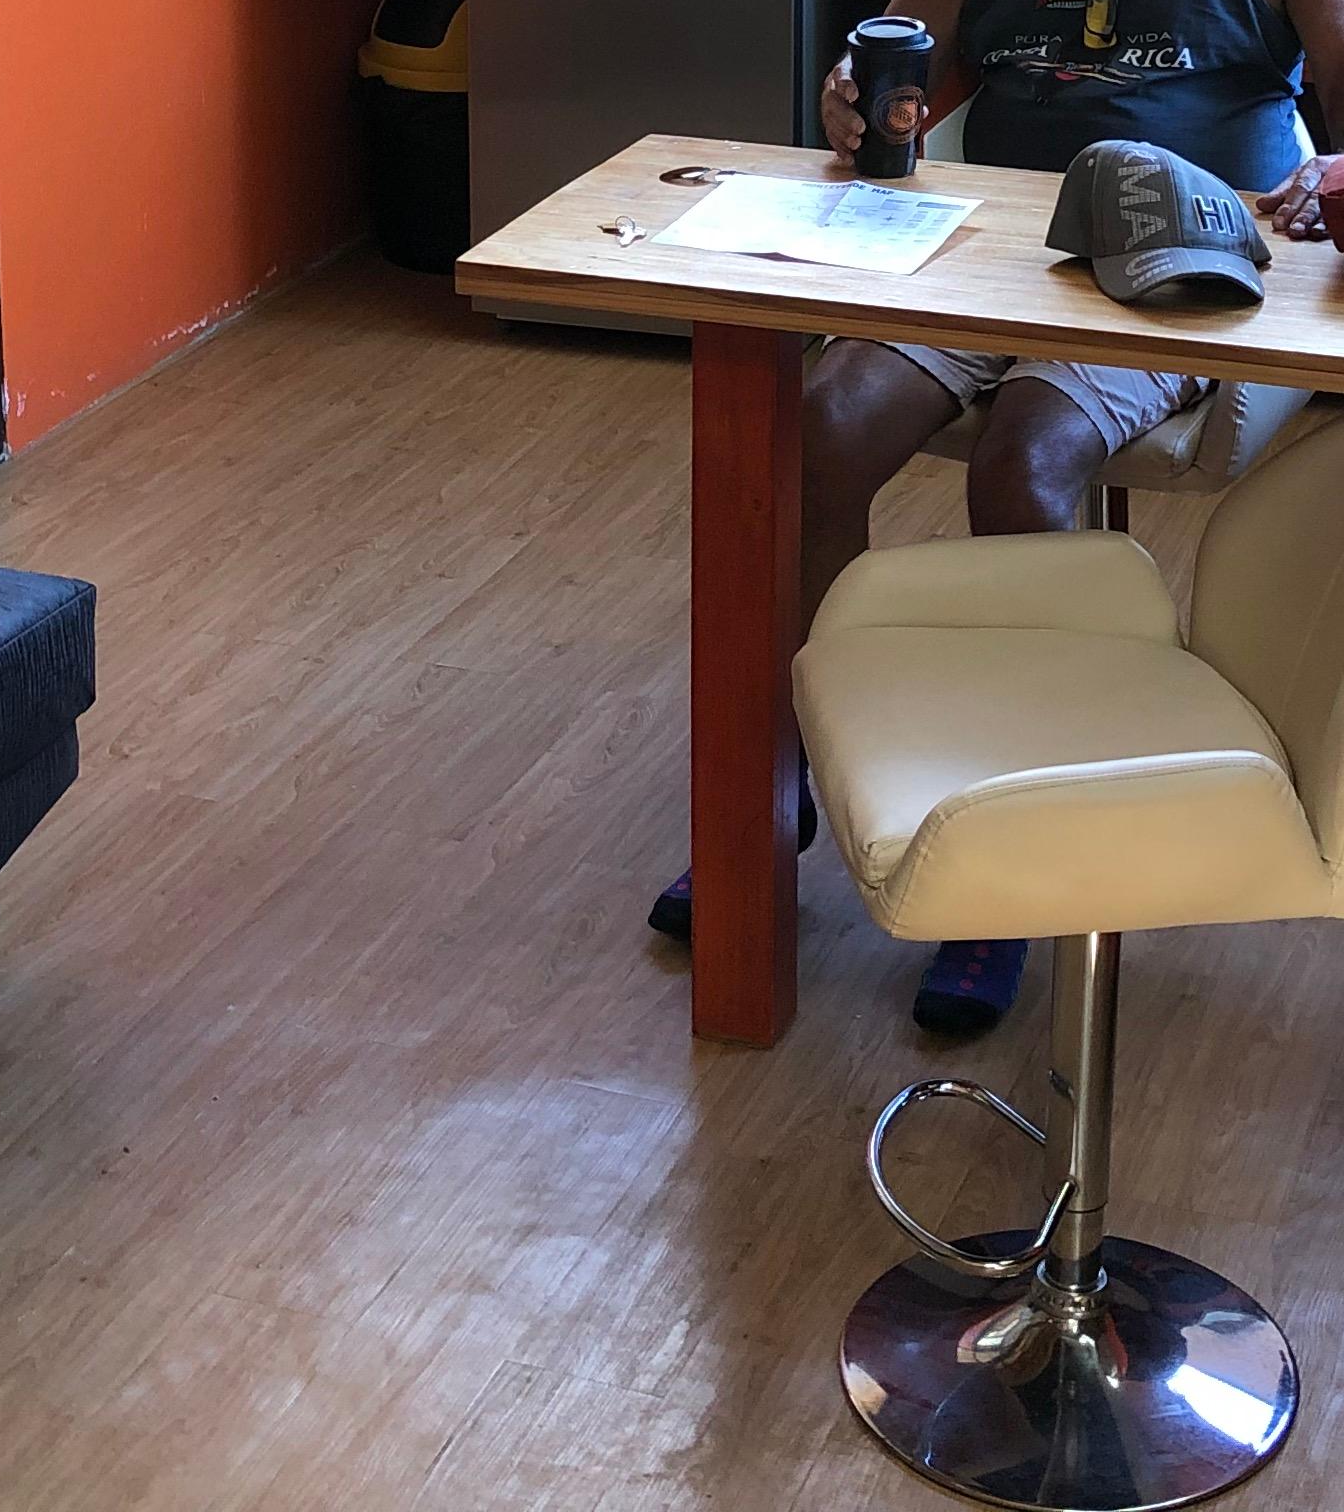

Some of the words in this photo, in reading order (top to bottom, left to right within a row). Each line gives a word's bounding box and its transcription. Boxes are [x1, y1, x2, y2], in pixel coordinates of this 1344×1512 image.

[1015, 34, 1063, 44] PURA
[1127, 31, 1172, 44] VIDA
[982, 44, 1048, 65] COA
[1118, 47, 1195, 70] RICA
[801, 182, 866, 191] NTEVERDE
[872, 187, 895, 195] MAP
[1191, 194, 1238, 237] HI
